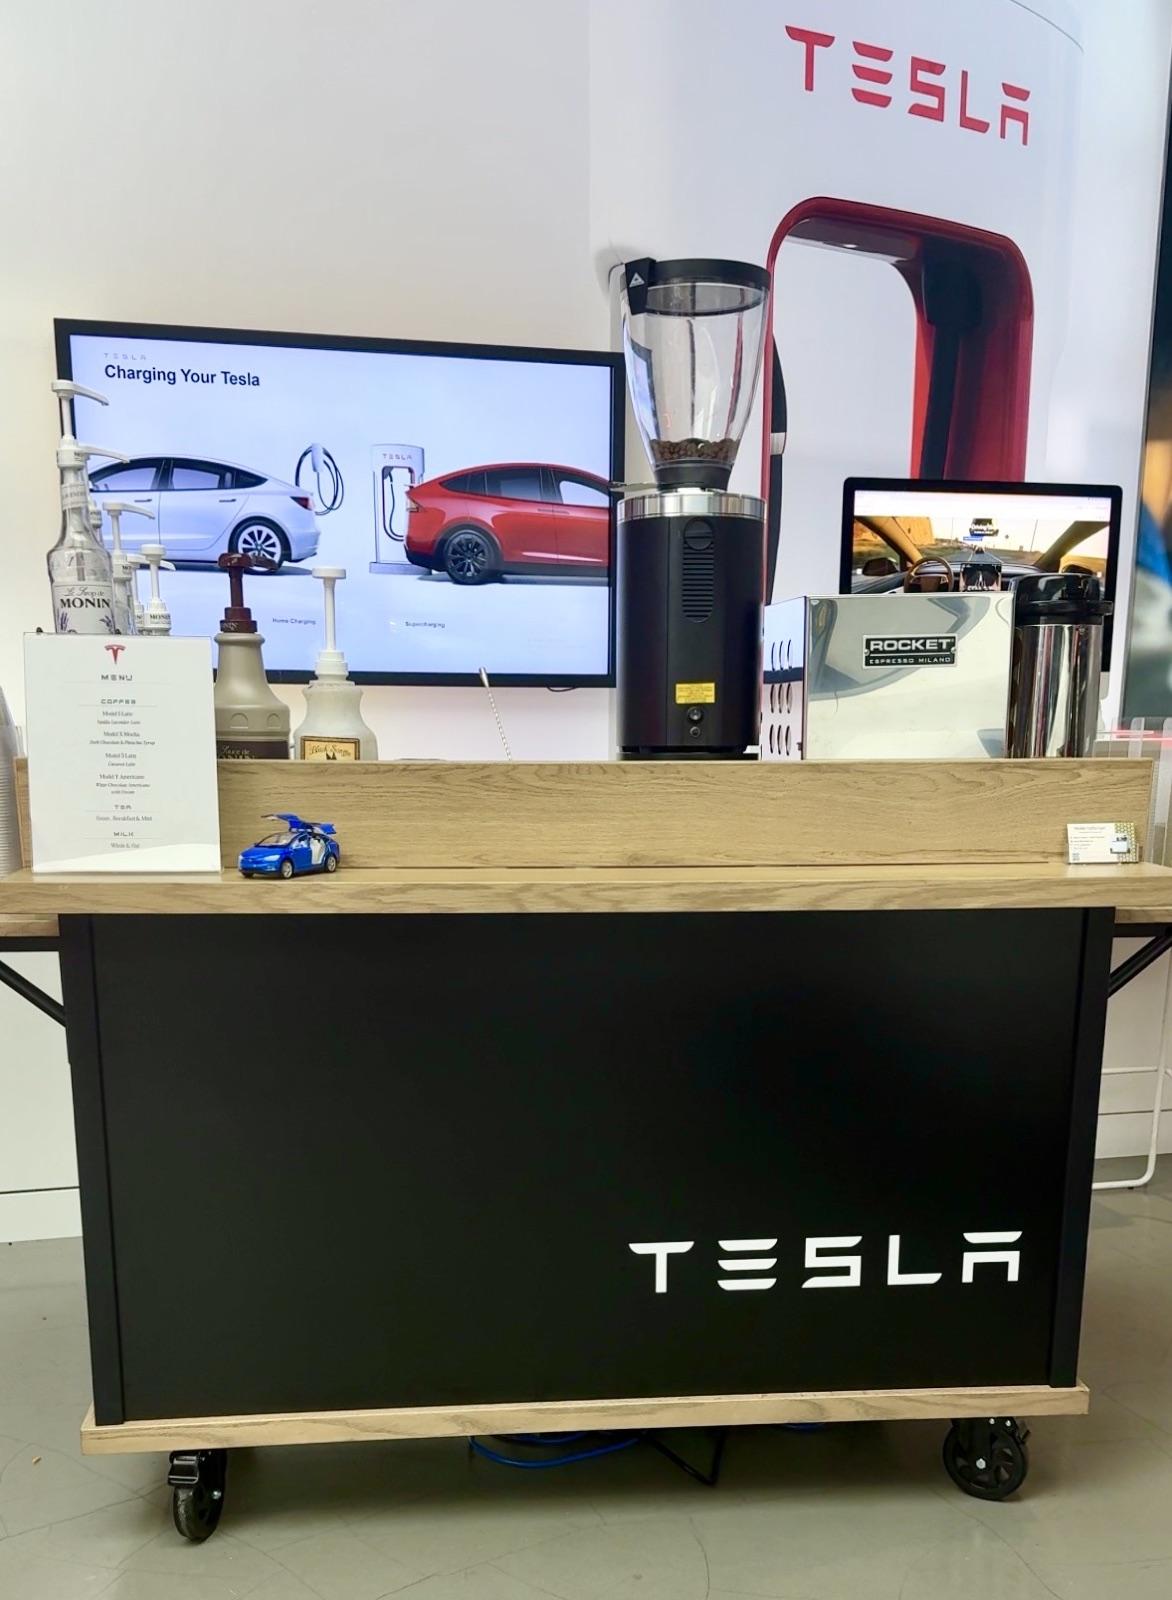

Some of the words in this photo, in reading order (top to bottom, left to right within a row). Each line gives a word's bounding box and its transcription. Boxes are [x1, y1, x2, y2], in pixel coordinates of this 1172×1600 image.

[785, 25, 1030, 146] TESLA
[104, 352, 147, 361] TESLA
[104, 364, 176, 385] Charging
[181, 368, 216, 384] Your
[221, 370, 260, 387] Tesla
[382, 453, 412, 461] TESLA
[60, 598, 111, 609] MONIN
[870, 639, 951, 652] ROCKET
[628, 1231, 1023, 1293] TESLA
